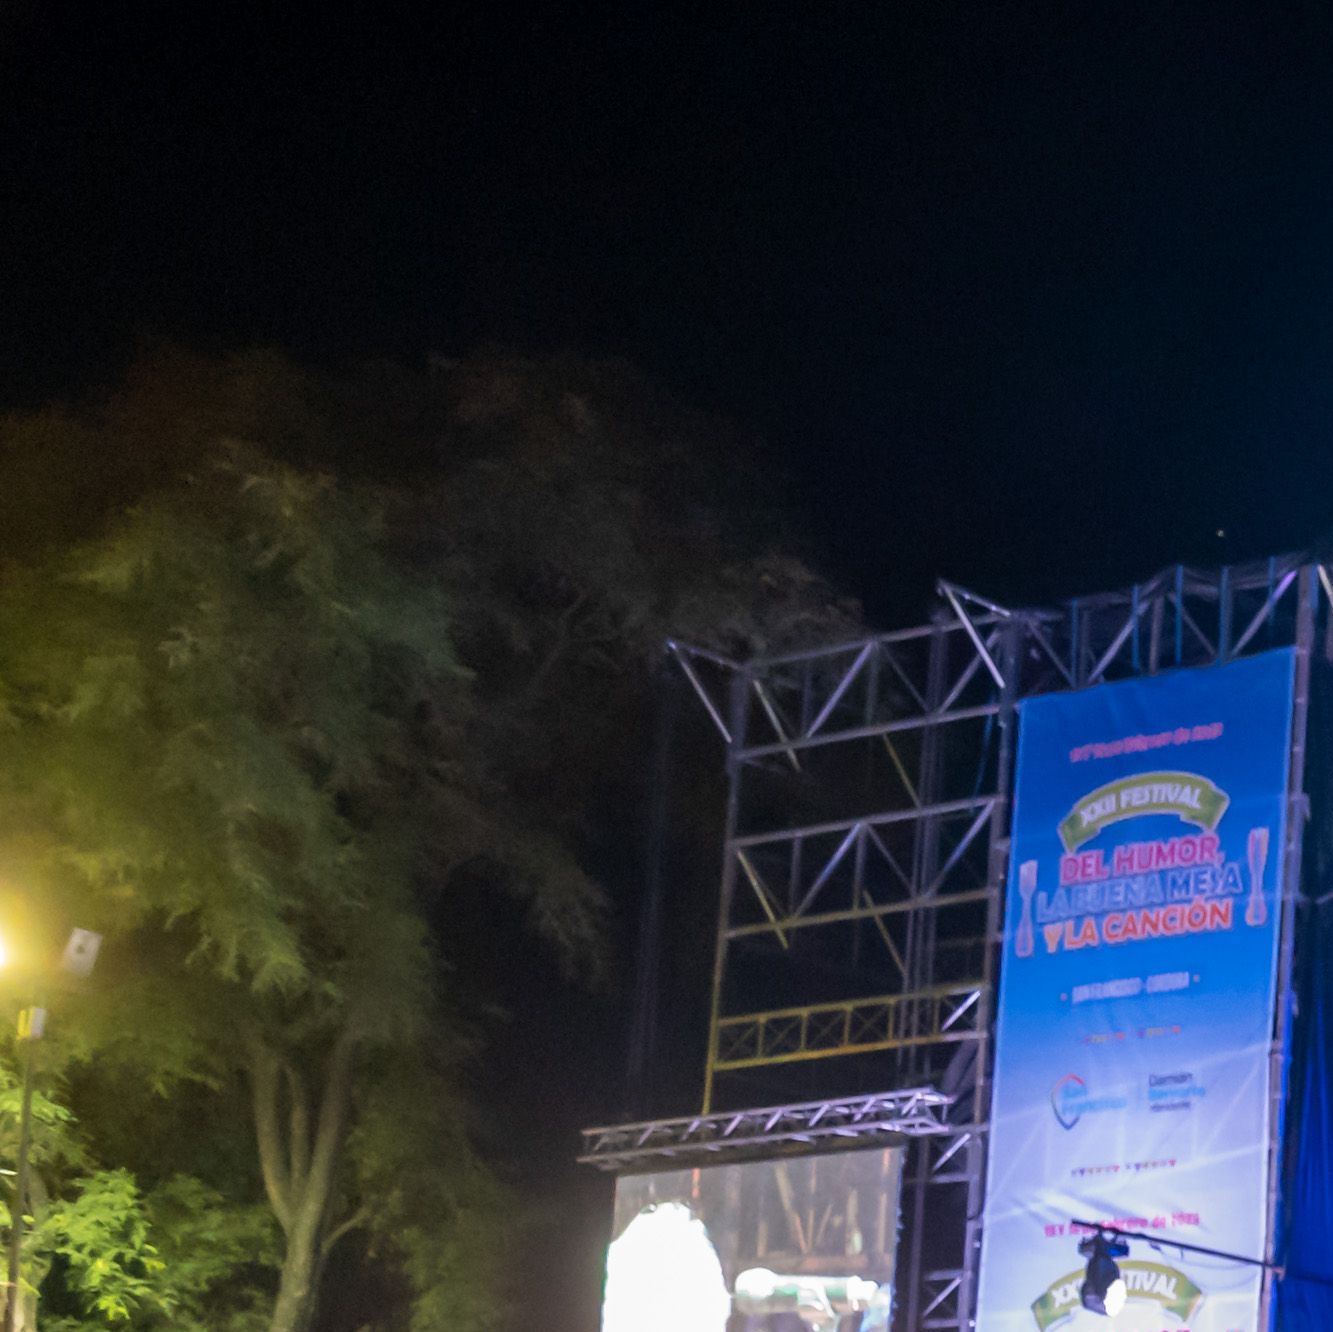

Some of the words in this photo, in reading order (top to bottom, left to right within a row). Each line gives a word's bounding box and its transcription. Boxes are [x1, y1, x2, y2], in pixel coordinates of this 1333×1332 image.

[1120, 783, 1203, 809] FESTIVAL
[1061, 850, 1110, 885] DEL
[1113, 833, 1225, 873] HUMOR,
[1037, 891, 1071, 923] LA
[1167, 862, 1244, 900] MESA
[1044, 925, 1063, 953] Y
[1064, 919, 1099, 949] LA
[1102, 895, 1234, 943] CANCIÓN
